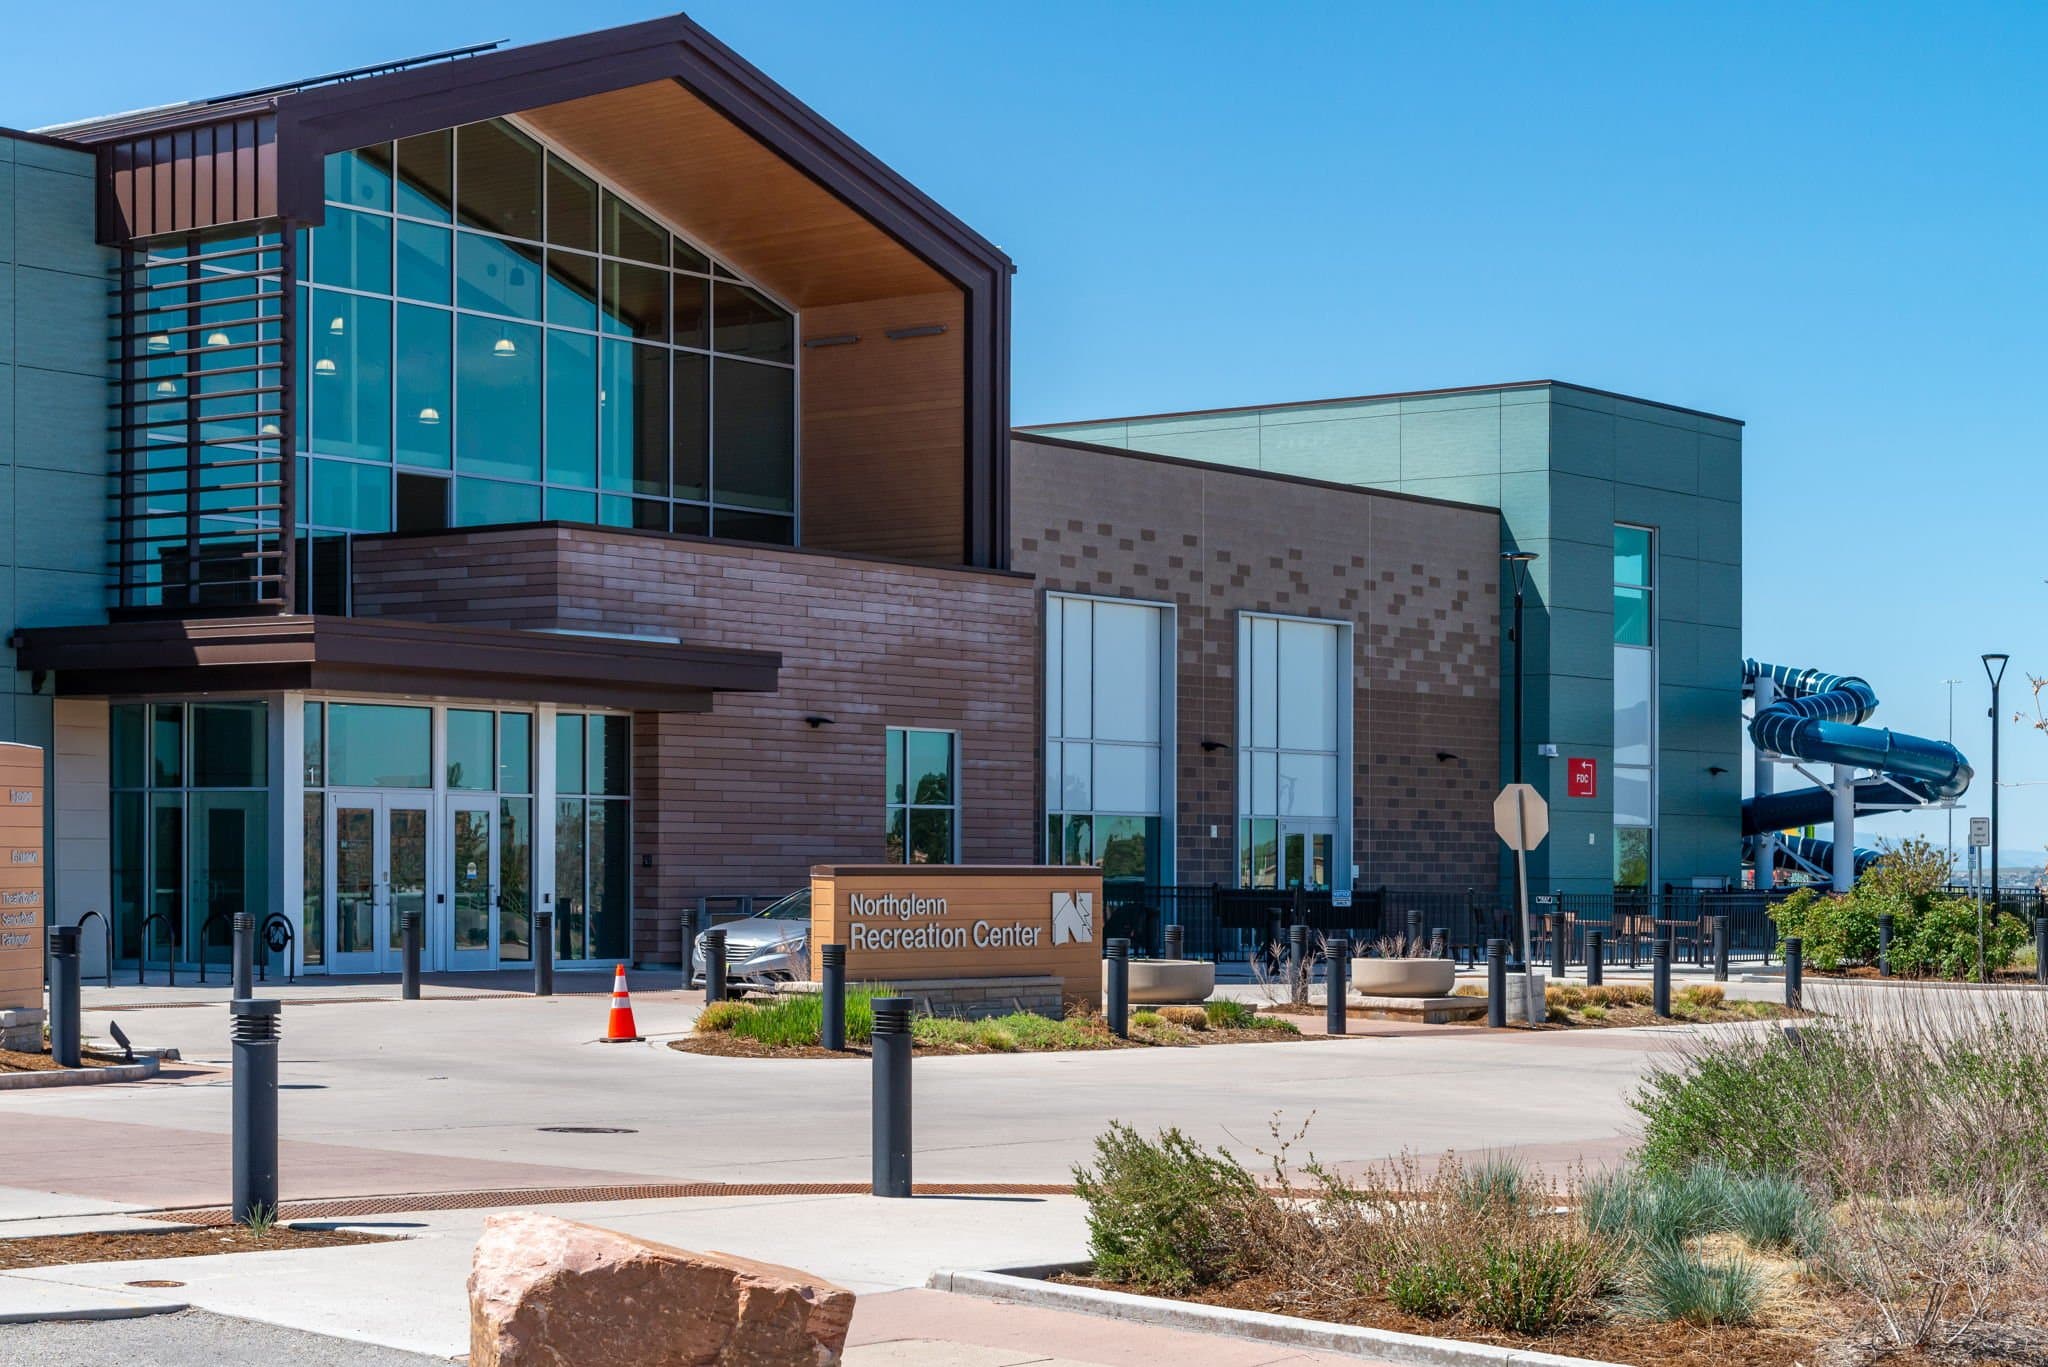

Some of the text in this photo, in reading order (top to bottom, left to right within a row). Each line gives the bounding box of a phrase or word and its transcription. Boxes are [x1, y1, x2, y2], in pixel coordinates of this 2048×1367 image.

[308, 767, 314, 785] 1
[1576, 773, 1589, 784] FDC
[850, 893, 947, 921] Northglenn
[850, 920, 1041, 950] Recreation Center
